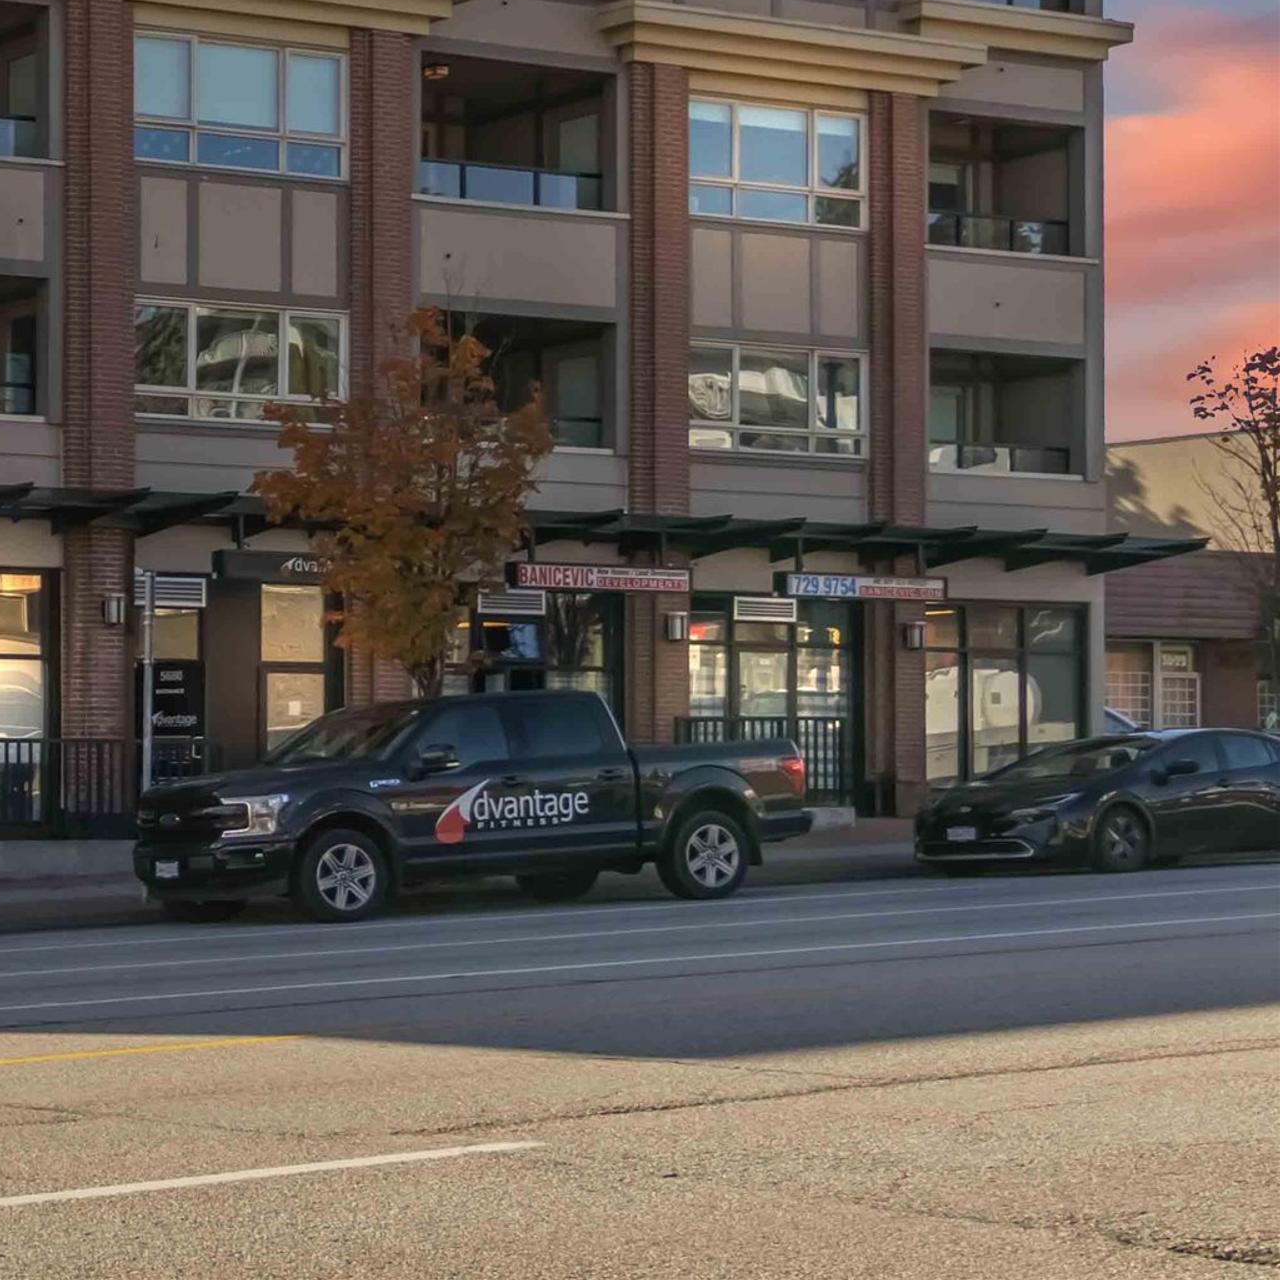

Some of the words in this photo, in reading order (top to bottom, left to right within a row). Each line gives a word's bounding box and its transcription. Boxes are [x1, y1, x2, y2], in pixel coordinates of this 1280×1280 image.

[519, 565, 593, 587] BANICEVIC
[597, 578, 685, 590] DEVELOPMENTS
[477, 817, 559, 829] FITNESS
